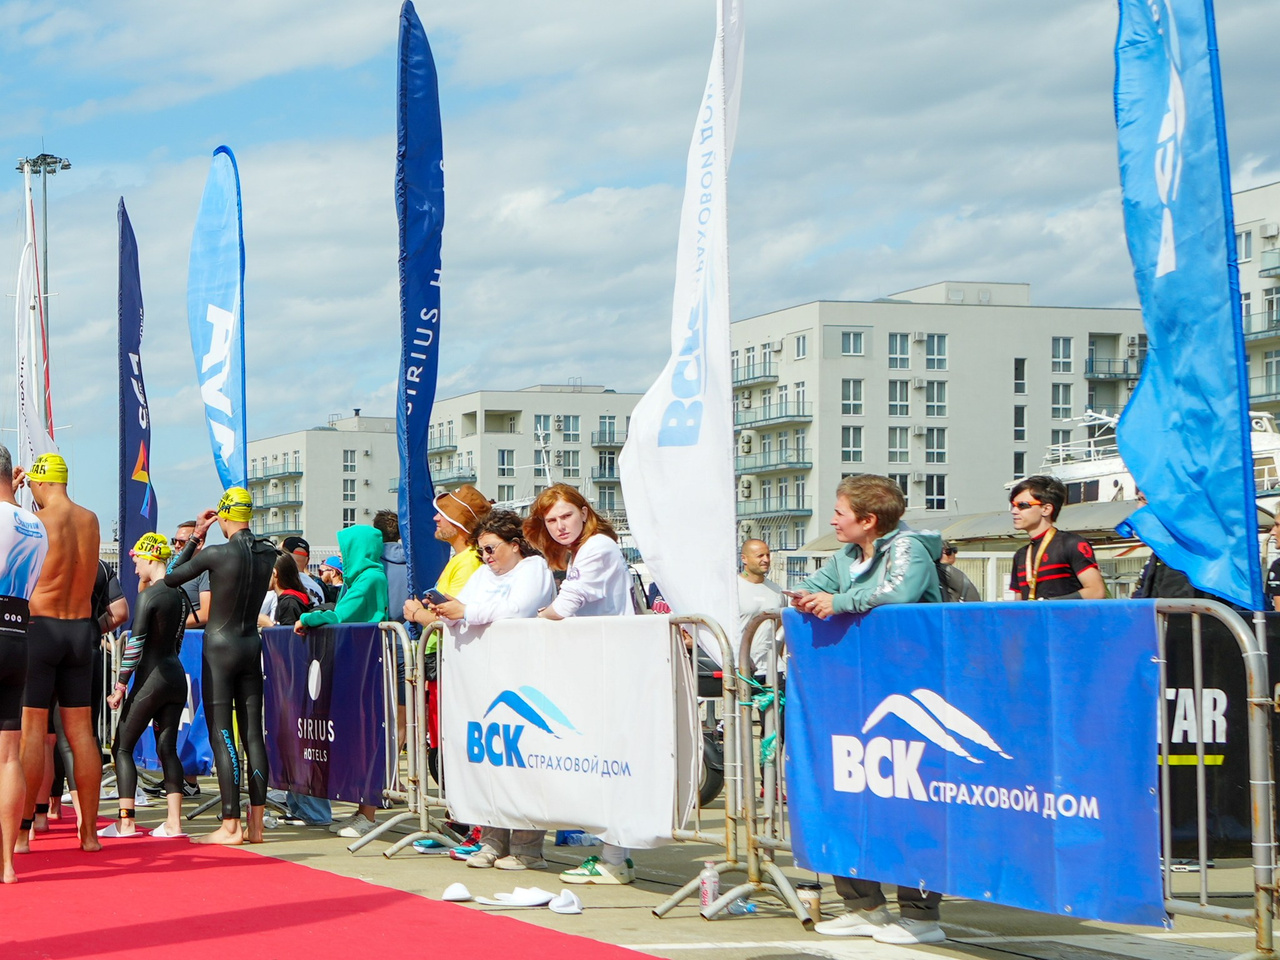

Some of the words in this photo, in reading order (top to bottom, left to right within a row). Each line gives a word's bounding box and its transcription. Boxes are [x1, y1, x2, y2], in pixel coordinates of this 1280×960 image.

[297, 717, 335, 743] SIRIUS
[466, 721, 527, 769] ВСК
[527, 753, 599, 774] СТРАХОВОЙ
[600, 759, 632, 778] ДОМ
[303, 747, 328, 762] HOTELS
[831, 734, 929, 802] ВСК
[928, 780, 1039, 814] СТРАХОВОЙ
[1042, 792, 1100, 820] ДОМ
